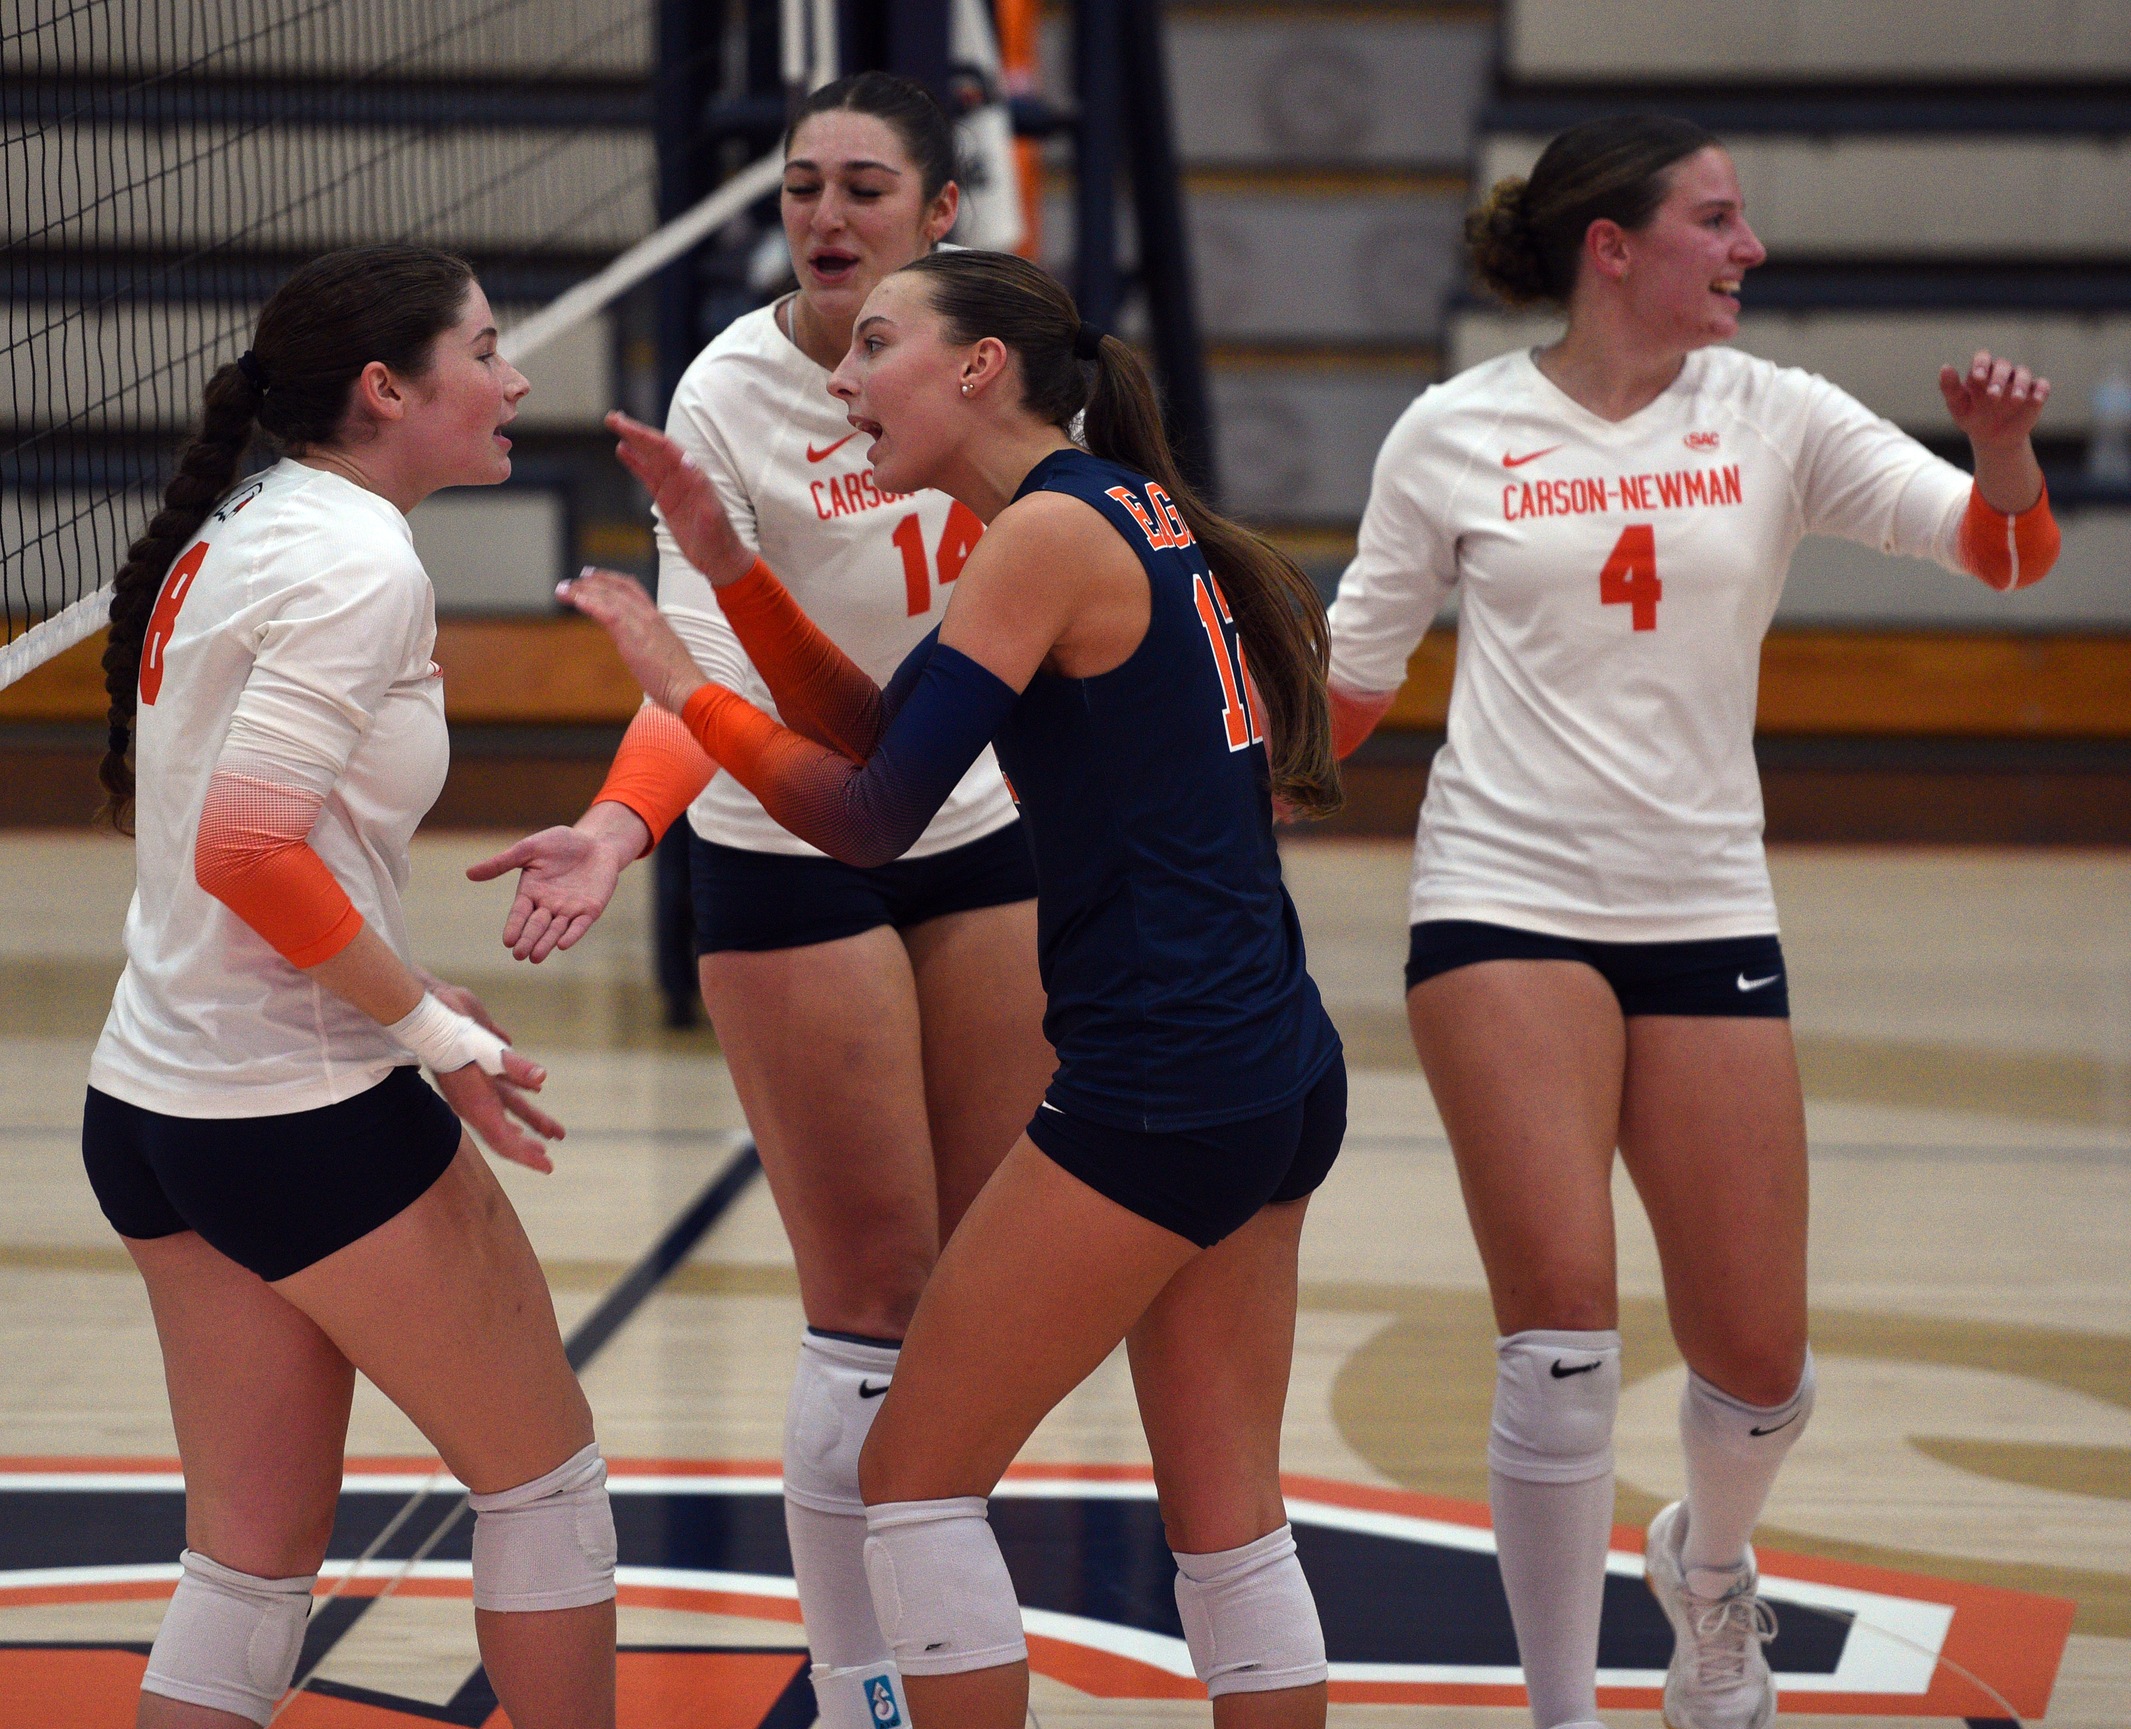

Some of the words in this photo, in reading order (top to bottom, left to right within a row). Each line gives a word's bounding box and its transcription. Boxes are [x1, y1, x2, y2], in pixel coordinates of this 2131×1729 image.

[809, 468, 914, 521] CARS
[1502, 463, 1743, 522] CARSON-NEWMAN
[892, 499, 985, 618] 14
[1599, 523, 1662, 632] 4
[140, 540, 210, 706] 8
